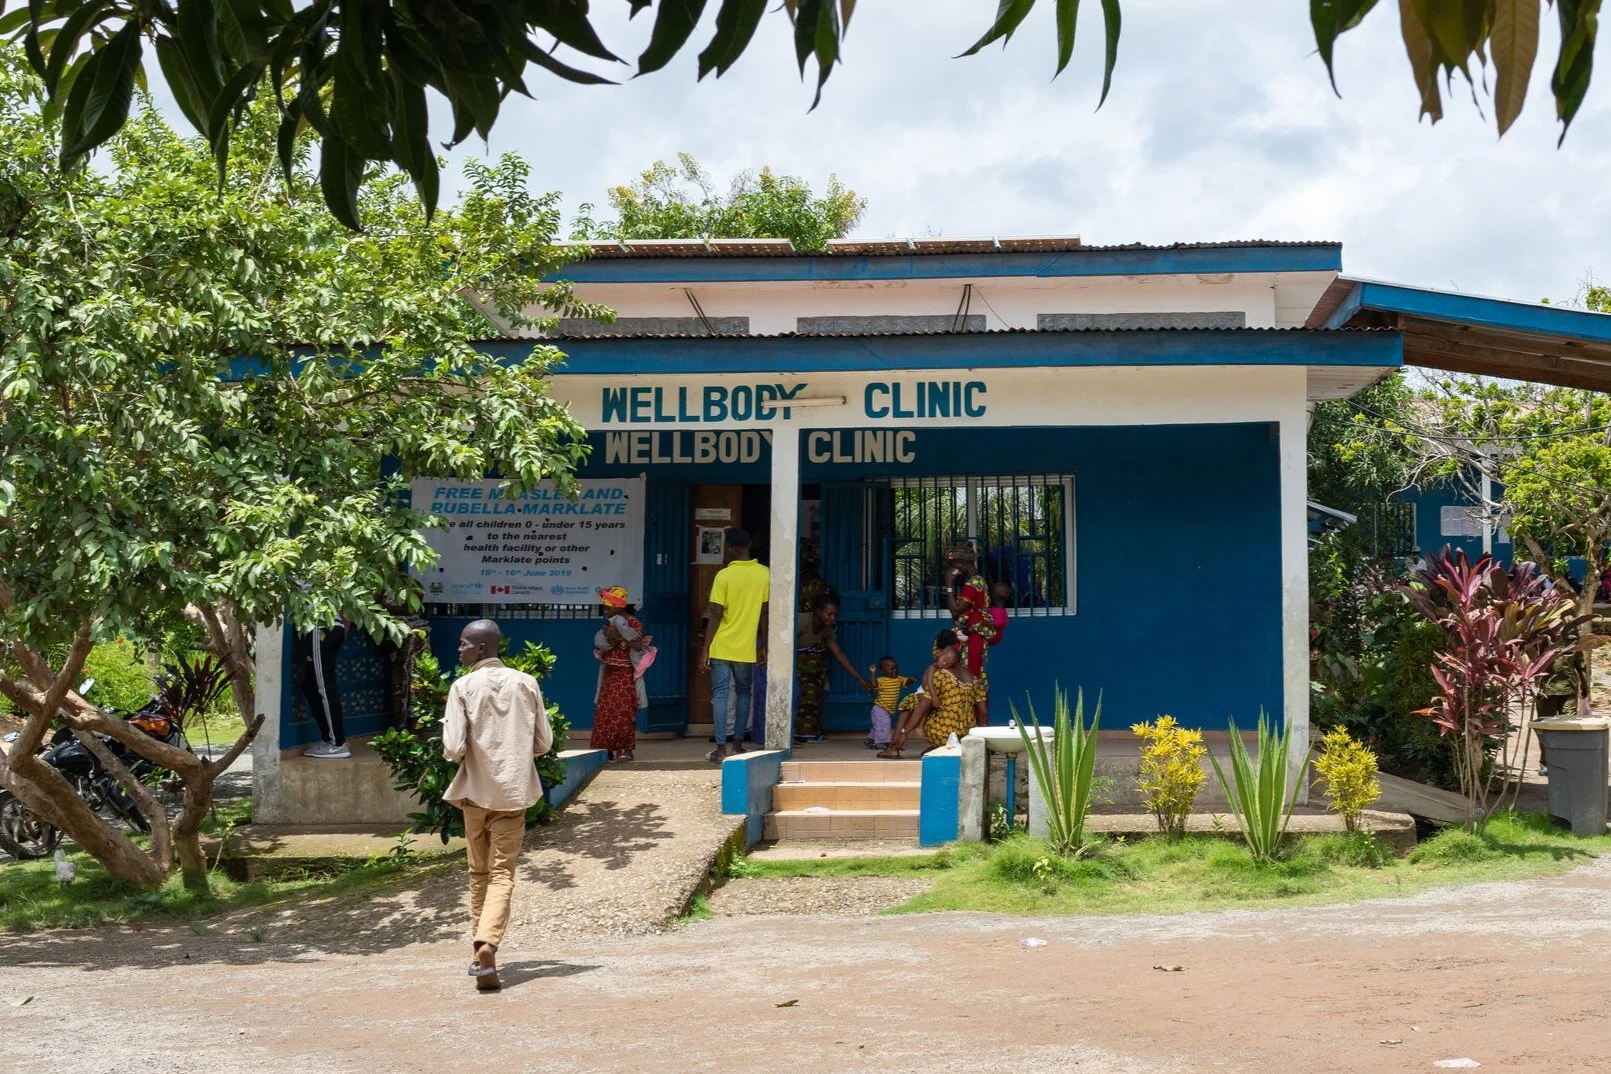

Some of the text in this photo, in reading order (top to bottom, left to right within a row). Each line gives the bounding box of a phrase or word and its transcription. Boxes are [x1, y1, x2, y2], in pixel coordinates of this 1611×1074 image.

[602, 381, 987, 423] WELLBODY CLINIC
[808, 430, 916, 463] CLINIC
[434, 487, 483, 499] FREE
[583, 487, 624, 500] AND
[431, 502, 626, 515] RUBELLA MARKLATE
[459, 520, 474, 529] all
[477, 520, 522, 529] children
[525, 520, 533, 529] 0
[542, 520, 576, 529] under
[579, 520, 593, 529] 15
[595, 521, 626, 531] years
[487, 532, 567, 541] to the nearest
[464, 543, 499, 552] health
[502, 543, 542, 553] facility
[560, 544, 591, 552] other
[481, 555, 571, 566] Marklate points
[523, 568, 546, 577] June
[549, 568, 573, 577] 2019
